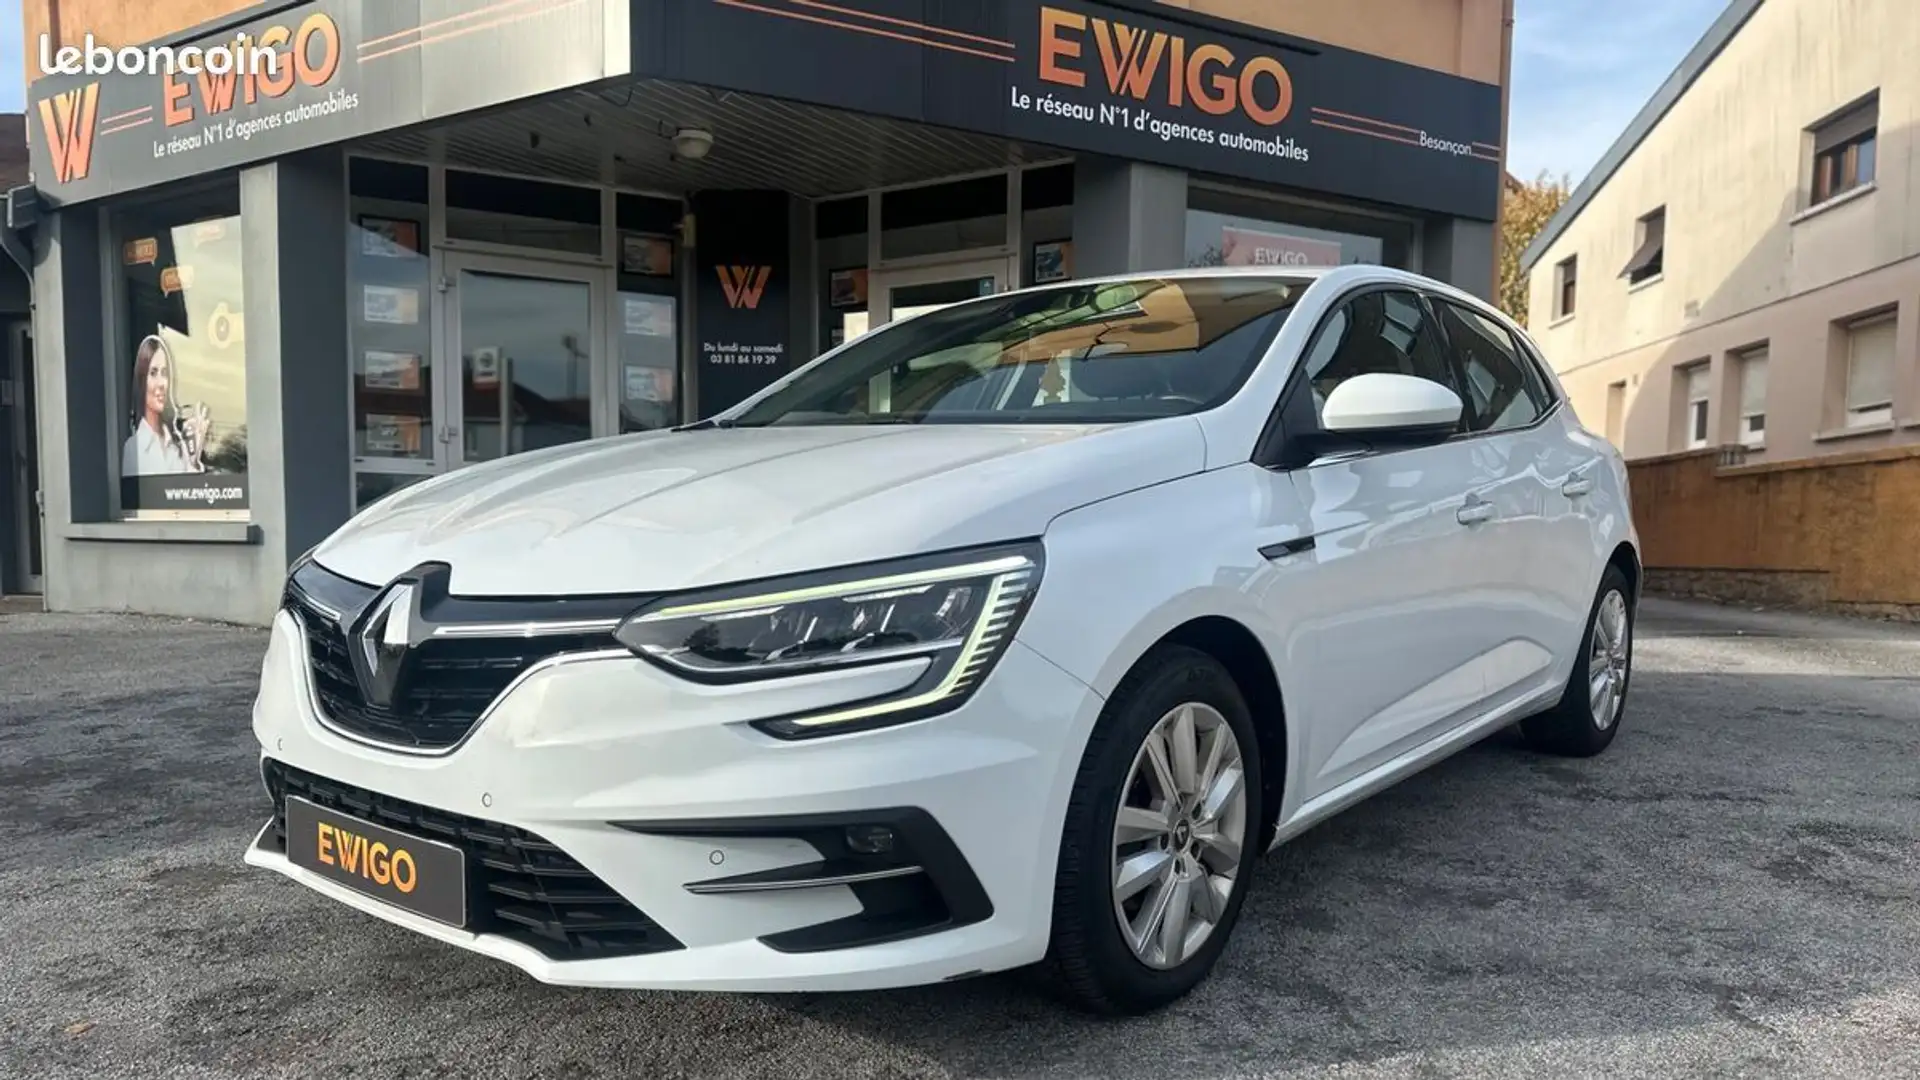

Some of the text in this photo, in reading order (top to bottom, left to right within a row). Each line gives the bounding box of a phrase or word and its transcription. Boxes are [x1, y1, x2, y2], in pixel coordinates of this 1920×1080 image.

[162, 12, 341, 127] EWIGO
[1039, 5, 1293, 126] EWIGO
[153, 141, 164, 158] Le
[167, 135, 202, 155] réseau
[284, 89, 359, 124] automobiles
[1011, 86, 1309, 161] Le réseau N°1 d'agences automobiles
[1420, 130, 1472, 157] Besançon
[704, 342, 716, 353] Du
[718, 342, 738, 353] lundi
[753, 343, 783, 353] samedi
[710, 355, 722, 364] 03
[752, 355, 763, 364] 19
[164, 482, 243, 505] www.ewigo.com
[317, 821, 417, 893] EWIGO
